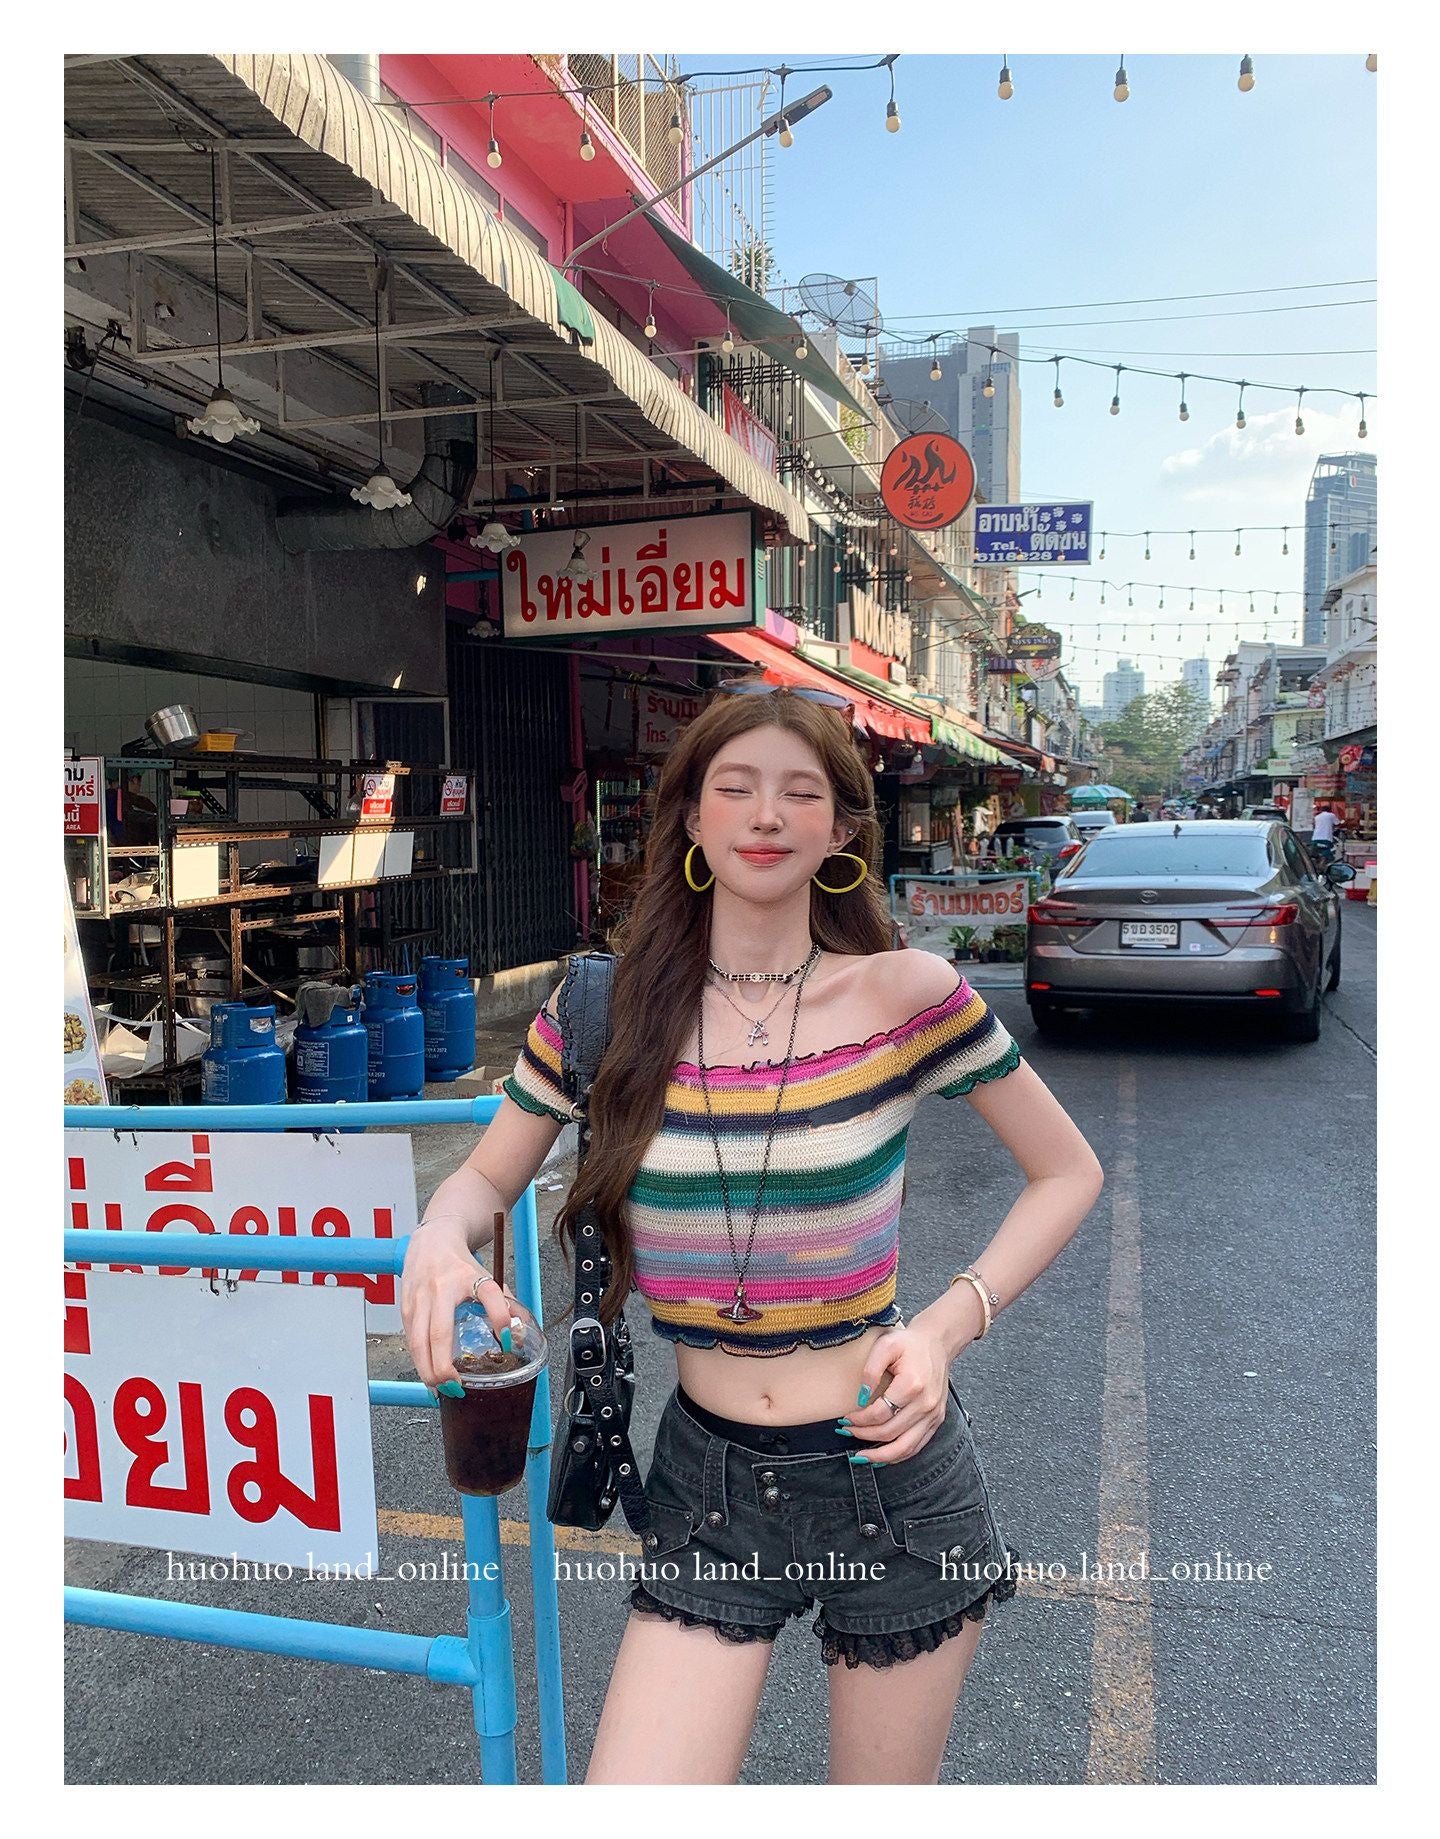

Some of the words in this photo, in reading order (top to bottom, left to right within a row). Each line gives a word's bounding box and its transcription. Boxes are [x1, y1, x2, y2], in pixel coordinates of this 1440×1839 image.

[506, 528, 745, 623] ใหม่เอี่ยม
[1148, 924, 1176, 935] 3502
